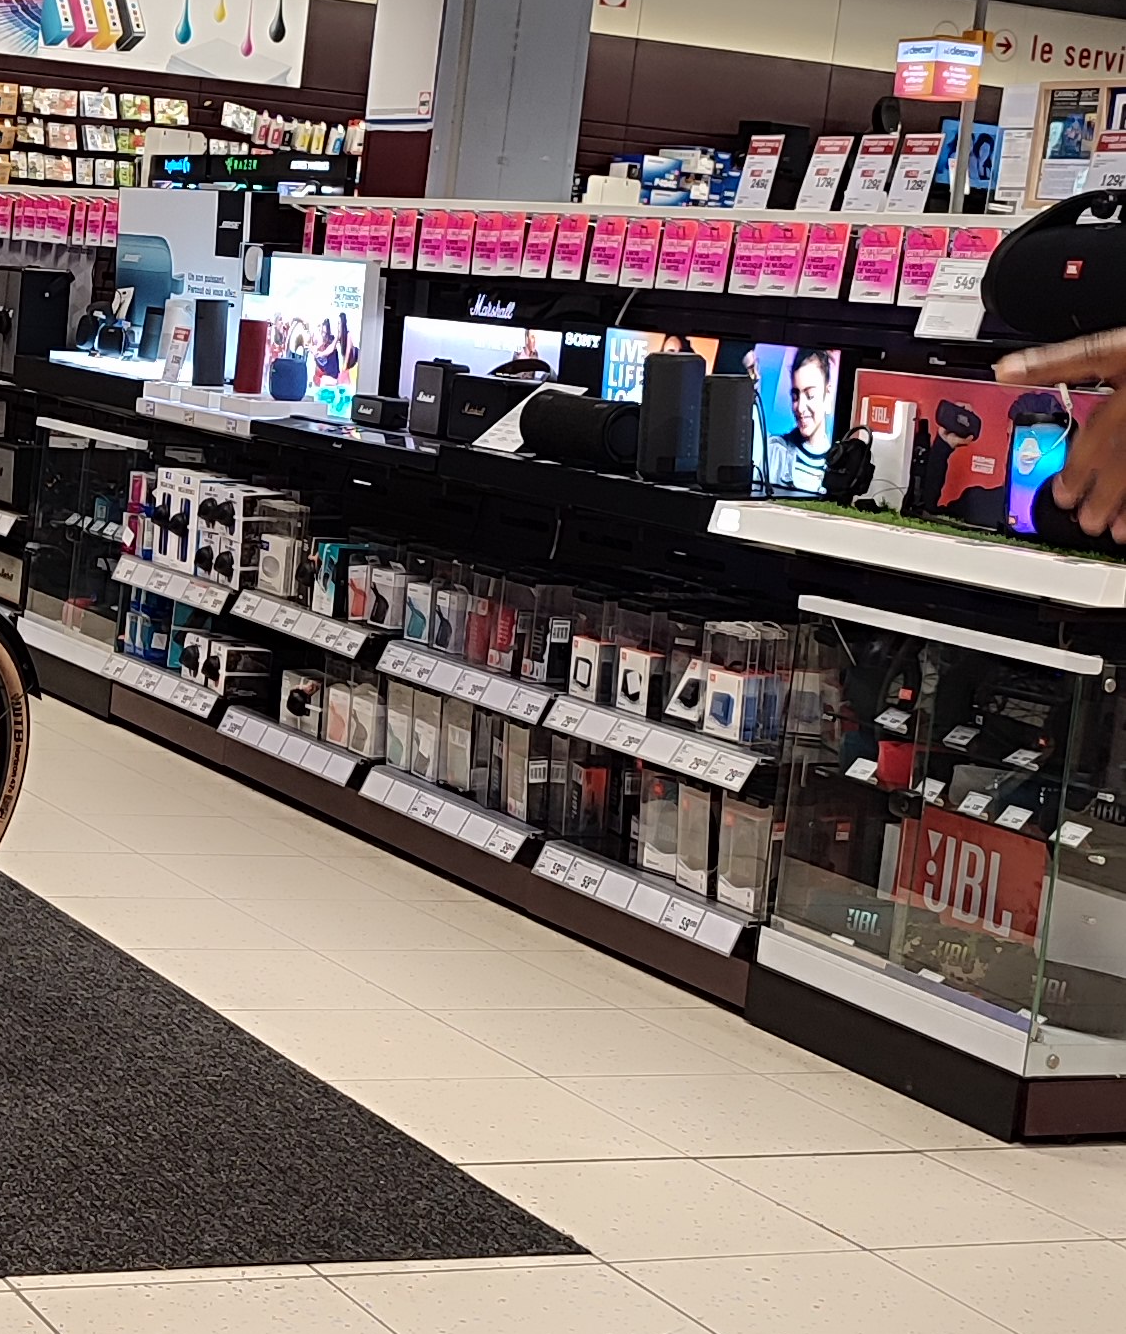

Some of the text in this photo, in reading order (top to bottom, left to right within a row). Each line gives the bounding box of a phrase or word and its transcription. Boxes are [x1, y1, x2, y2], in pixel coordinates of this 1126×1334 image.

[1031, 34, 1126, 74] le servi
[469, 293, 516, 319] Marshall
[564, 331, 602, 348] SONY
[610, 337, 648, 364] LIVE
[608, 362, 644, 388] LIFE
[921, 827, 1014, 939] JBL
[846, 907, 882, 937] JBL
